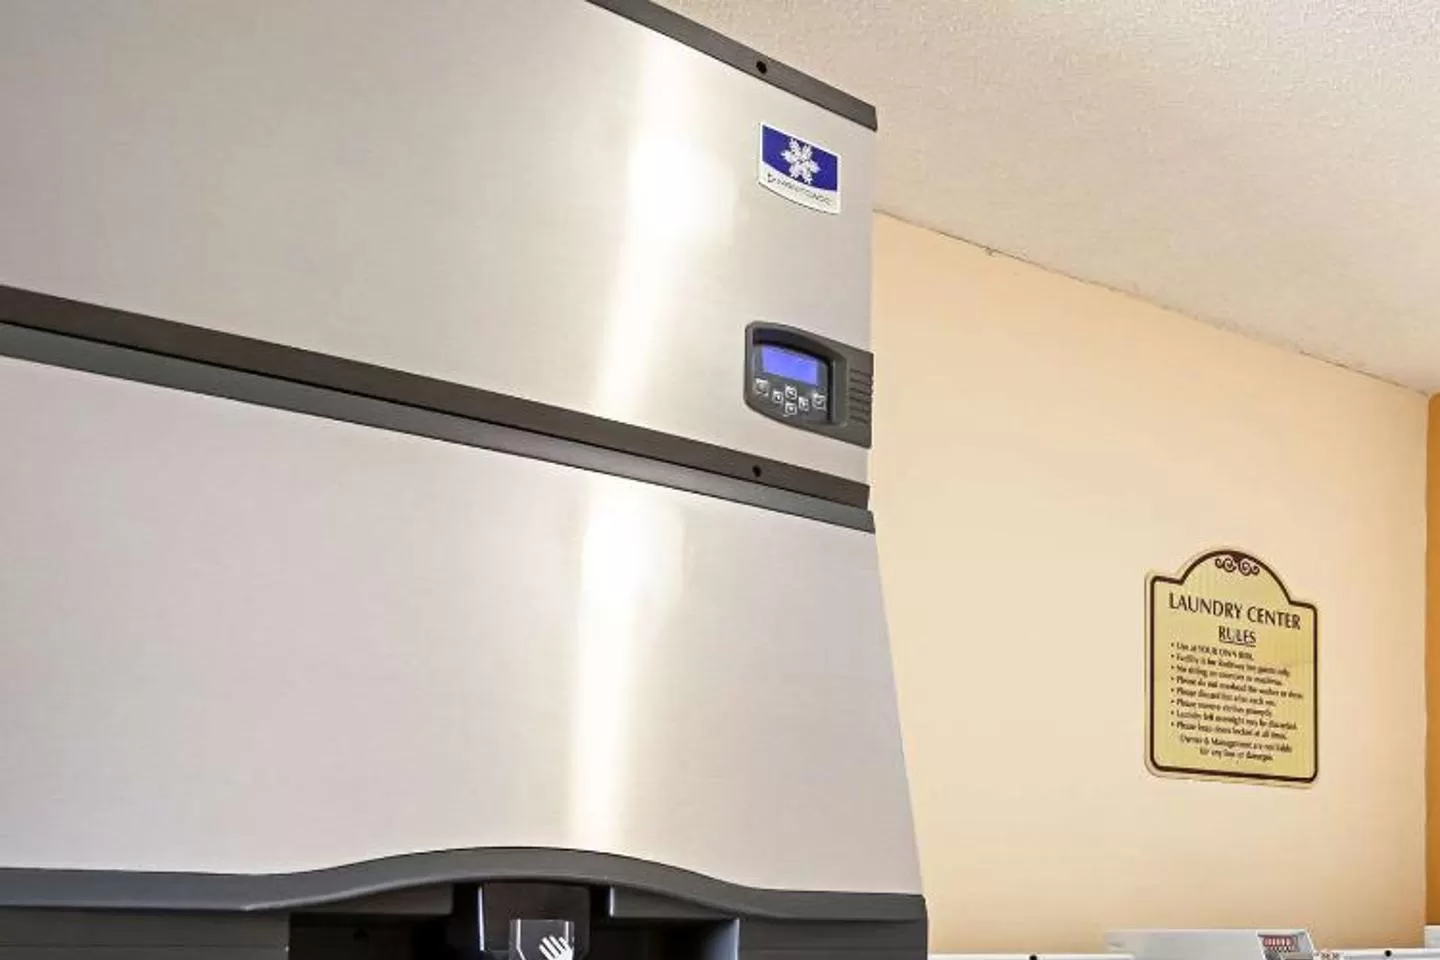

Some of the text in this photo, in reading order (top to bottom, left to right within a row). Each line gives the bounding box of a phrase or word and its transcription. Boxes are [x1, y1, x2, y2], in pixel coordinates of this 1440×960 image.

[1169, 593, 1301, 630] LAUNDRY CENTER
[1218, 625, 1256, 646] RULES
